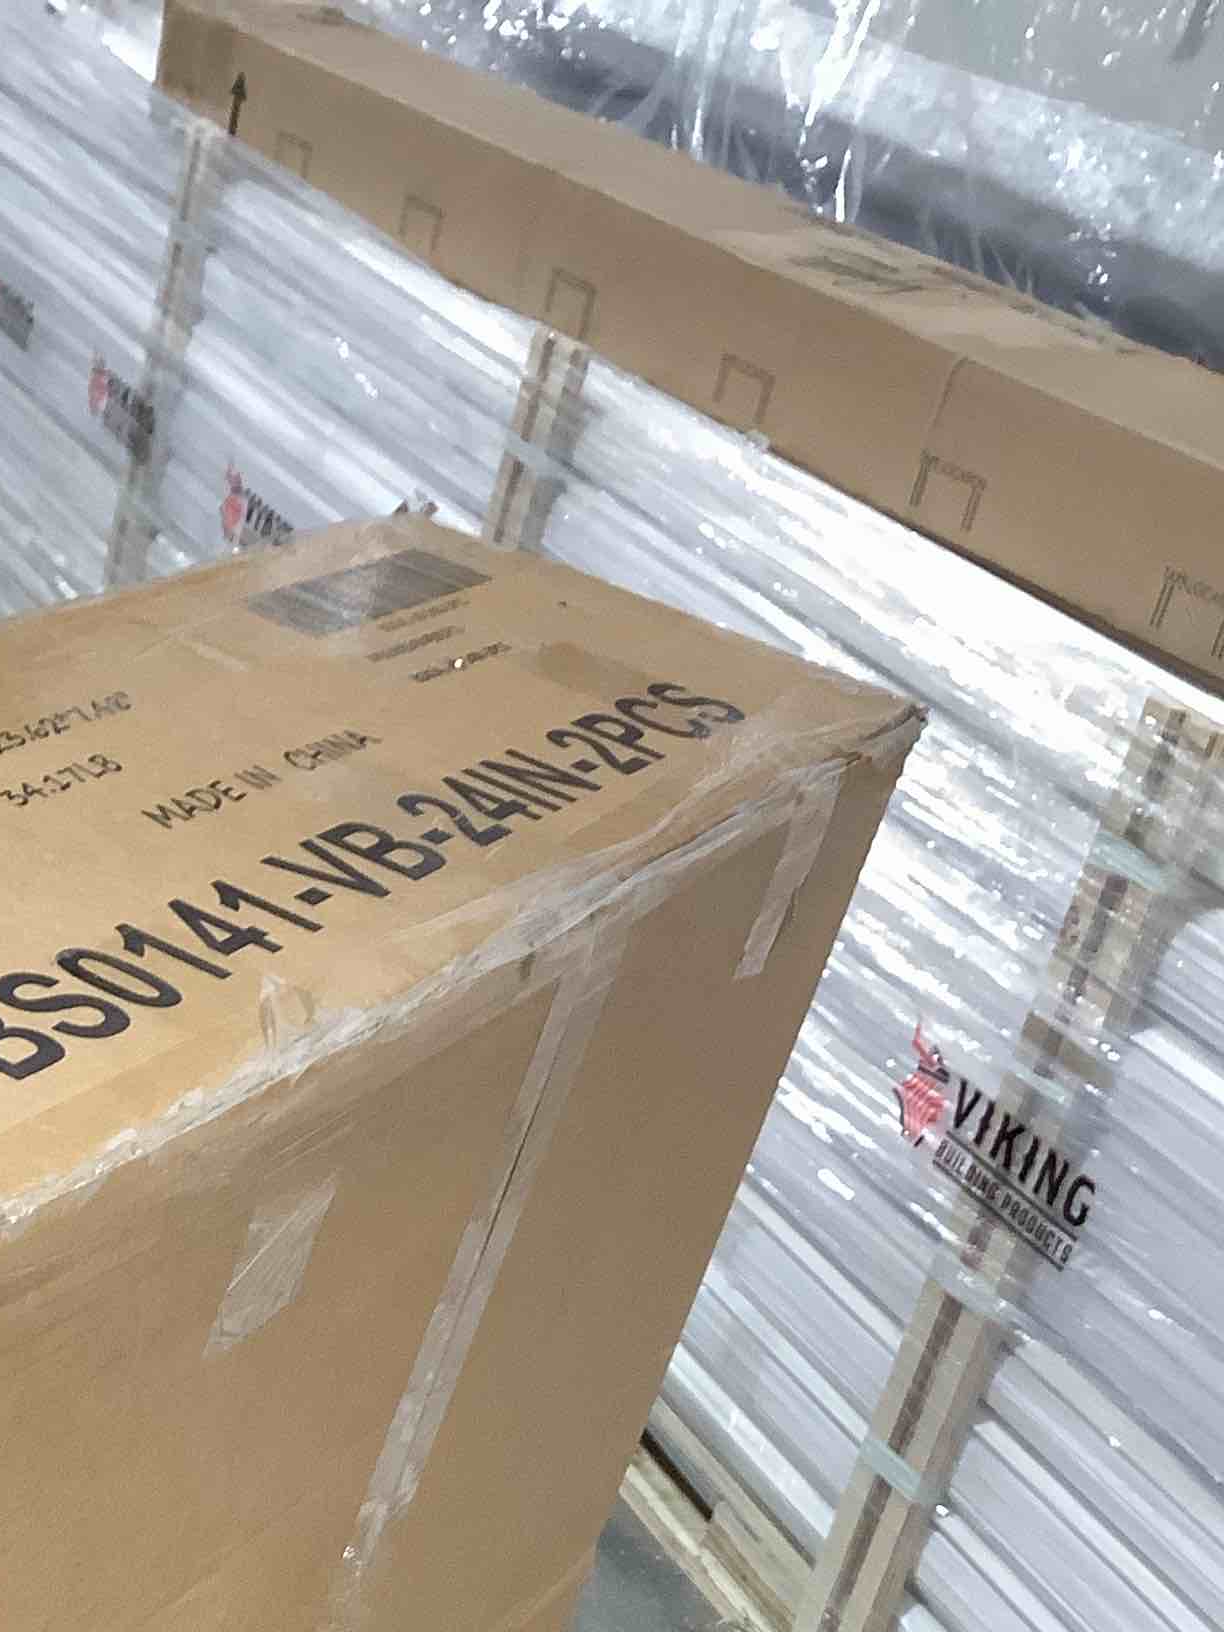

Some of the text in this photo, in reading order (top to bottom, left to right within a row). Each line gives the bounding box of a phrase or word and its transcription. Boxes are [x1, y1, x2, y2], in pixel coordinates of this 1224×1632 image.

[141, 729, 383, 829] MADE IN CHINA
[935, 1137, 1074, 1265] BUILDING PRODUCTS
[952, 1078, 1096, 1227] VIKING
